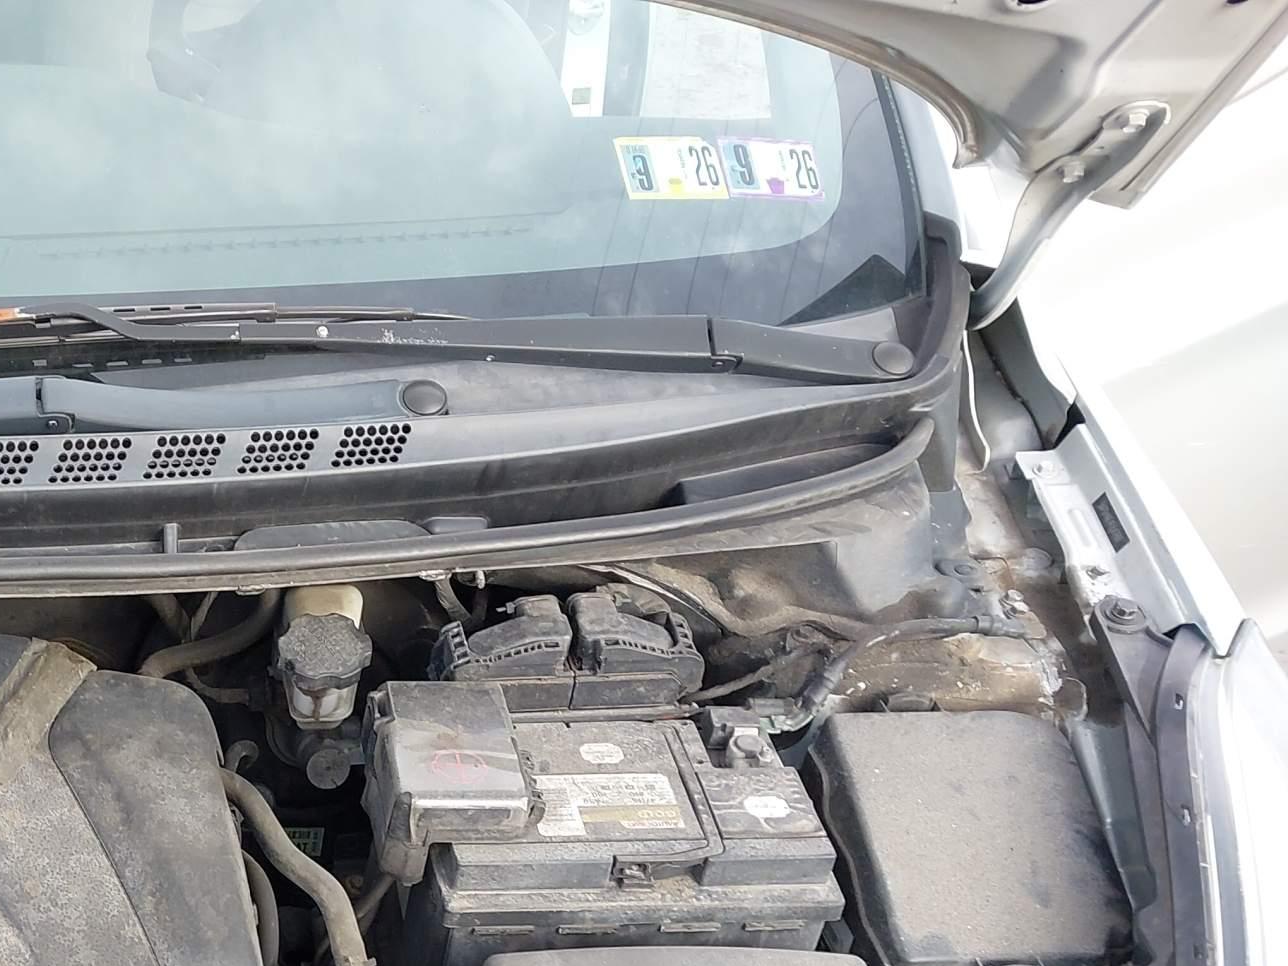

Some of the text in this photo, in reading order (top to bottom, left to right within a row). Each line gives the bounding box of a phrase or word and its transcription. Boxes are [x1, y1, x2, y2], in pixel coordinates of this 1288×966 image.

[688, 145, 720, 186] 26
[733, 144, 756, 186] 9
[789, 148, 819, 189] 26
